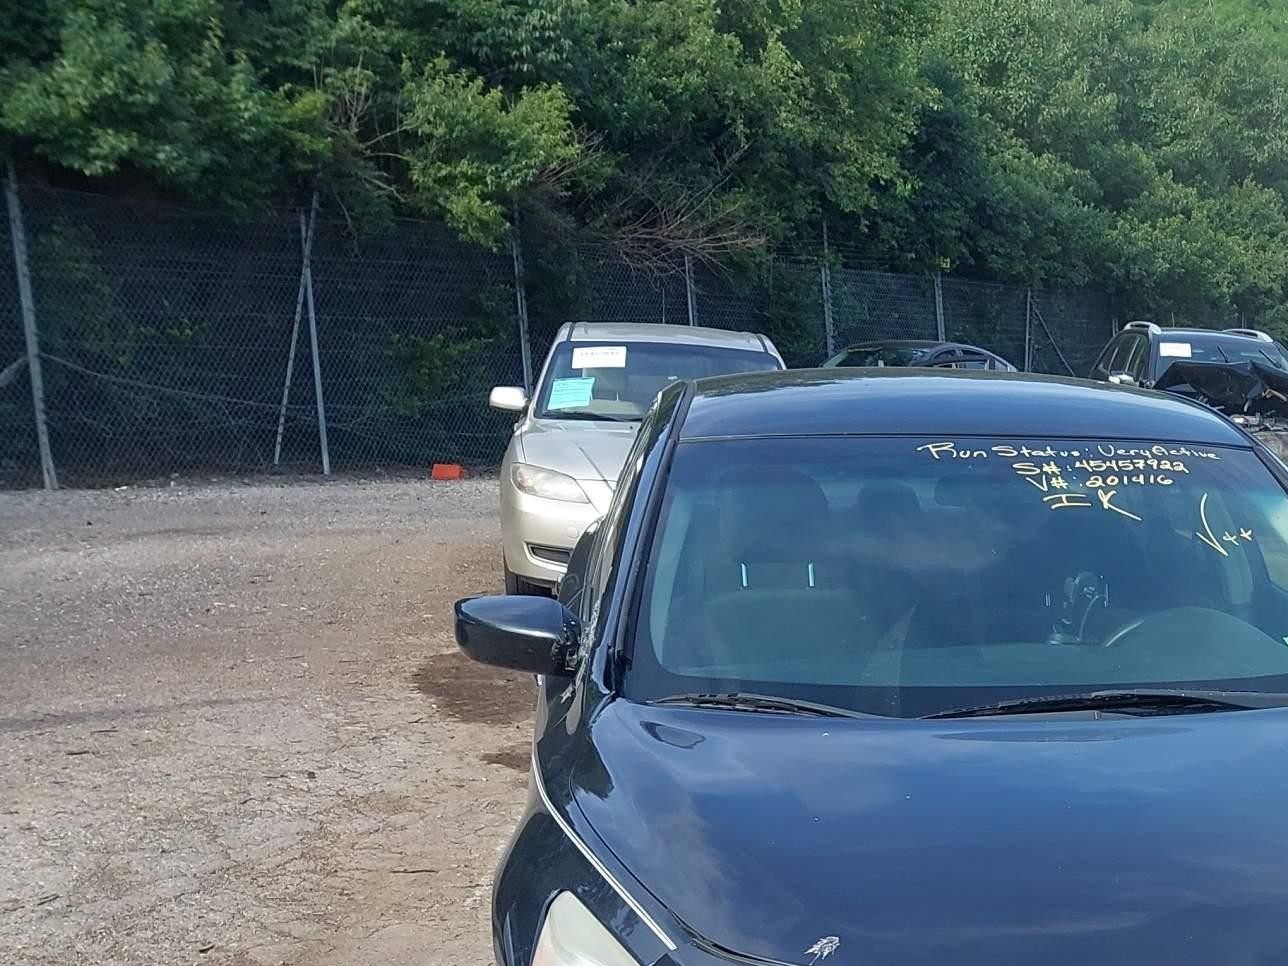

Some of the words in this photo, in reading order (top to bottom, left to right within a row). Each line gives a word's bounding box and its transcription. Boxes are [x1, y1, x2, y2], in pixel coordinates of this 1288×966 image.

[916, 441, 988, 460] Run
[1075, 459, 1190, 474] 45457922
[1085, 475, 1174, 488] 201416
